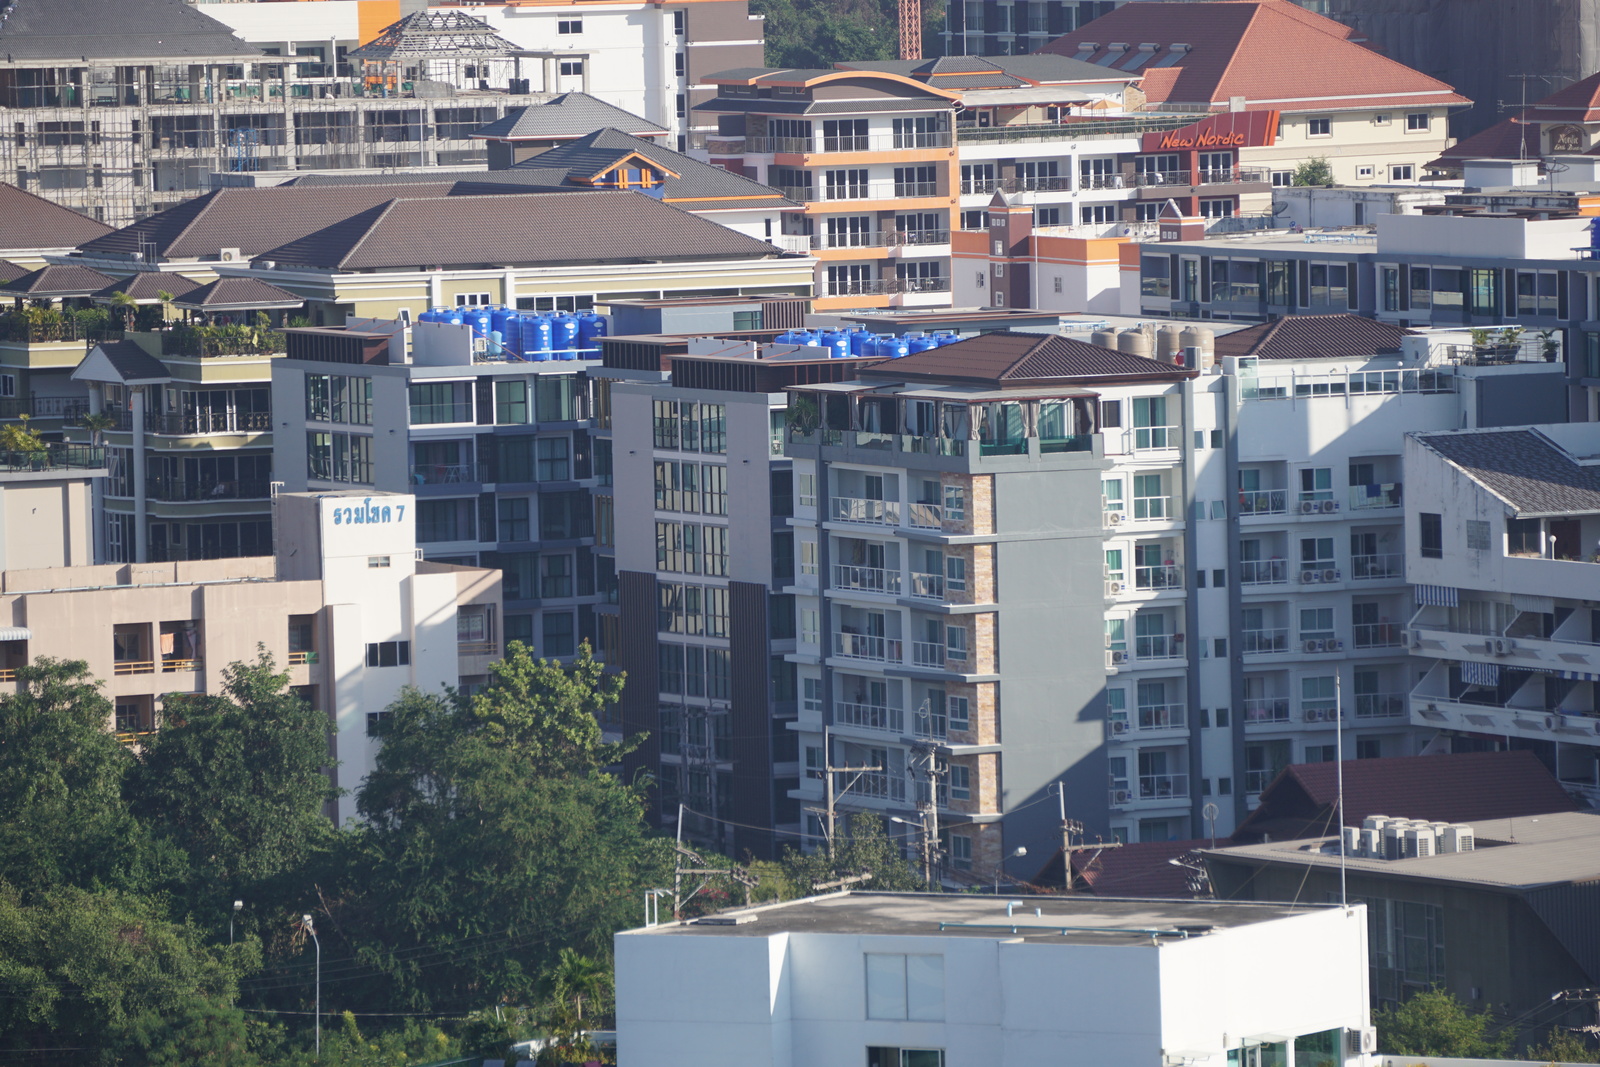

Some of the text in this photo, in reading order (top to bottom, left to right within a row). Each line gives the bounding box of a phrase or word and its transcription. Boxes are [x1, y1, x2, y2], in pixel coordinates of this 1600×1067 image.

[1160, 127, 1244, 148] New Nordic
[333, 497, 405, 525] รวมโชค 7
